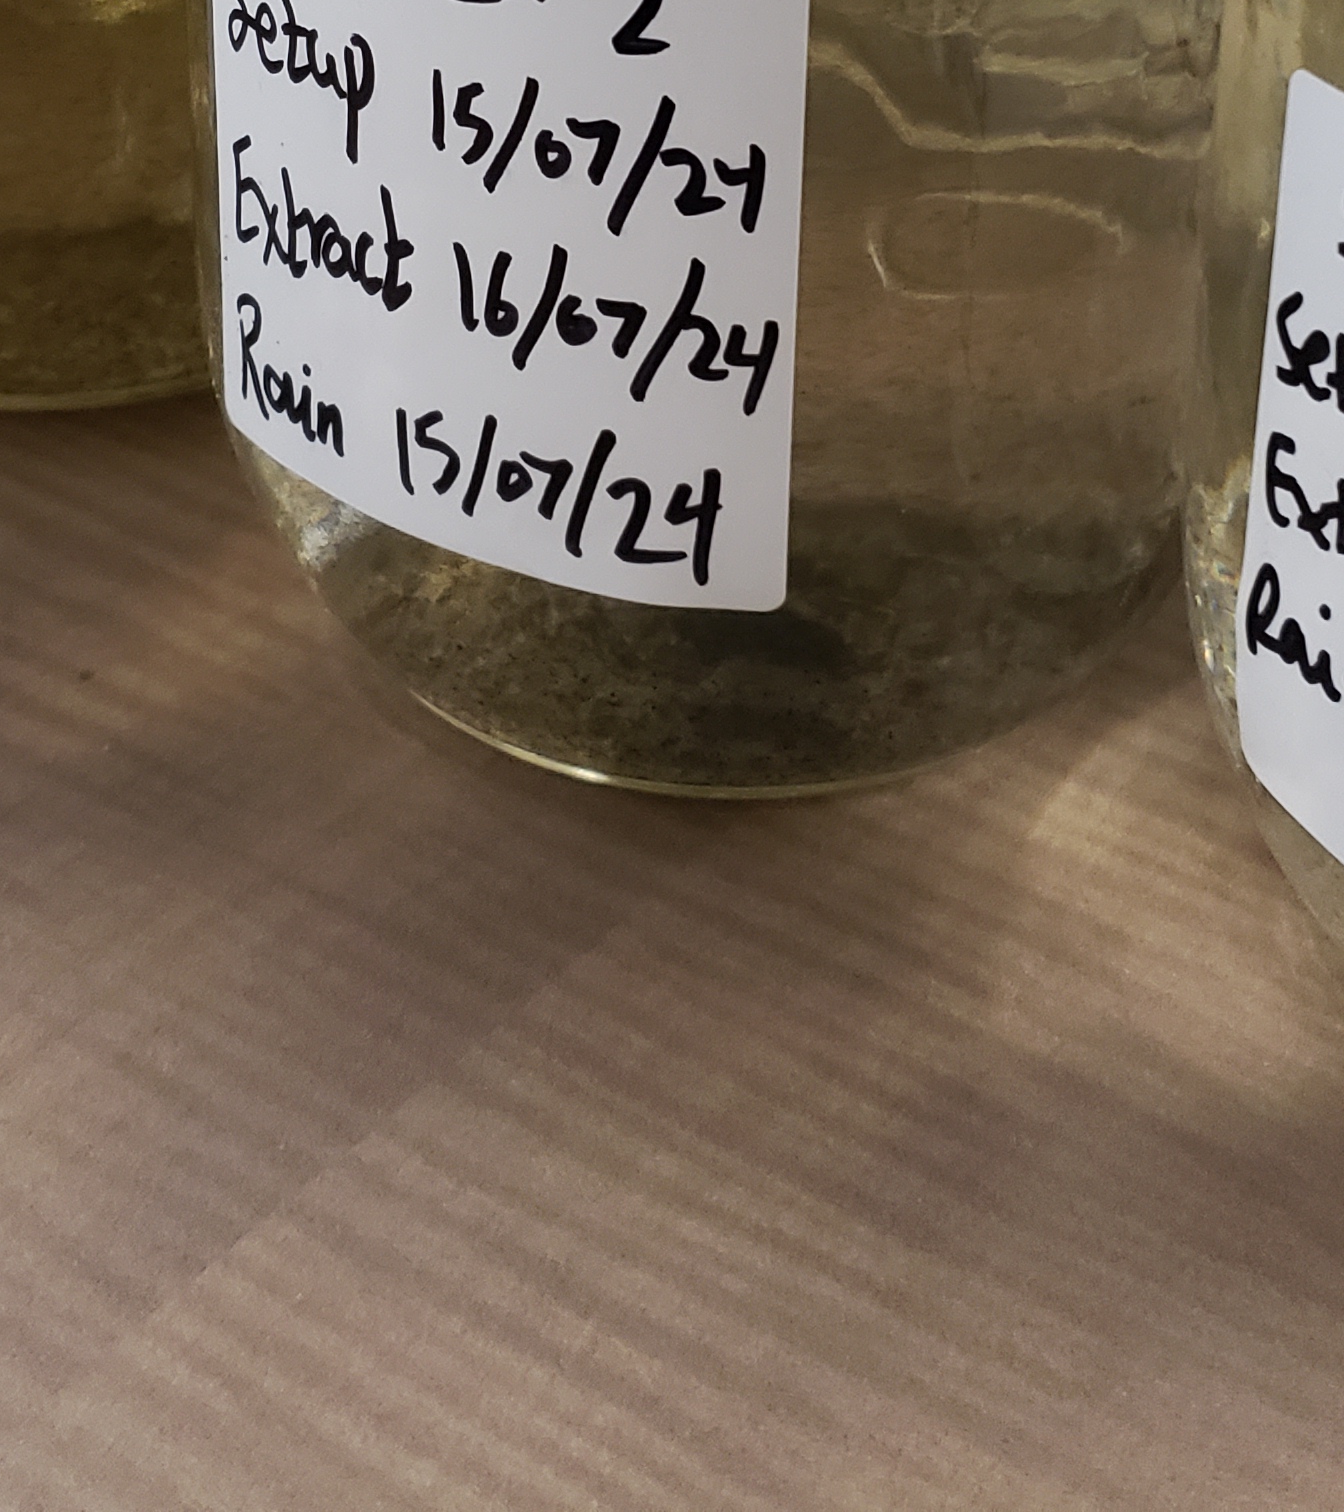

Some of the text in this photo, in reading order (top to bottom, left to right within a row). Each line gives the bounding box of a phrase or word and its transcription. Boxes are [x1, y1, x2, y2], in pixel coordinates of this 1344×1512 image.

[230, 134, 781, 417] Extract 16/07/24
[430, 67, 767, 238] 15/07/24
[236, 292, 724, 587] Rain 15/07/24
